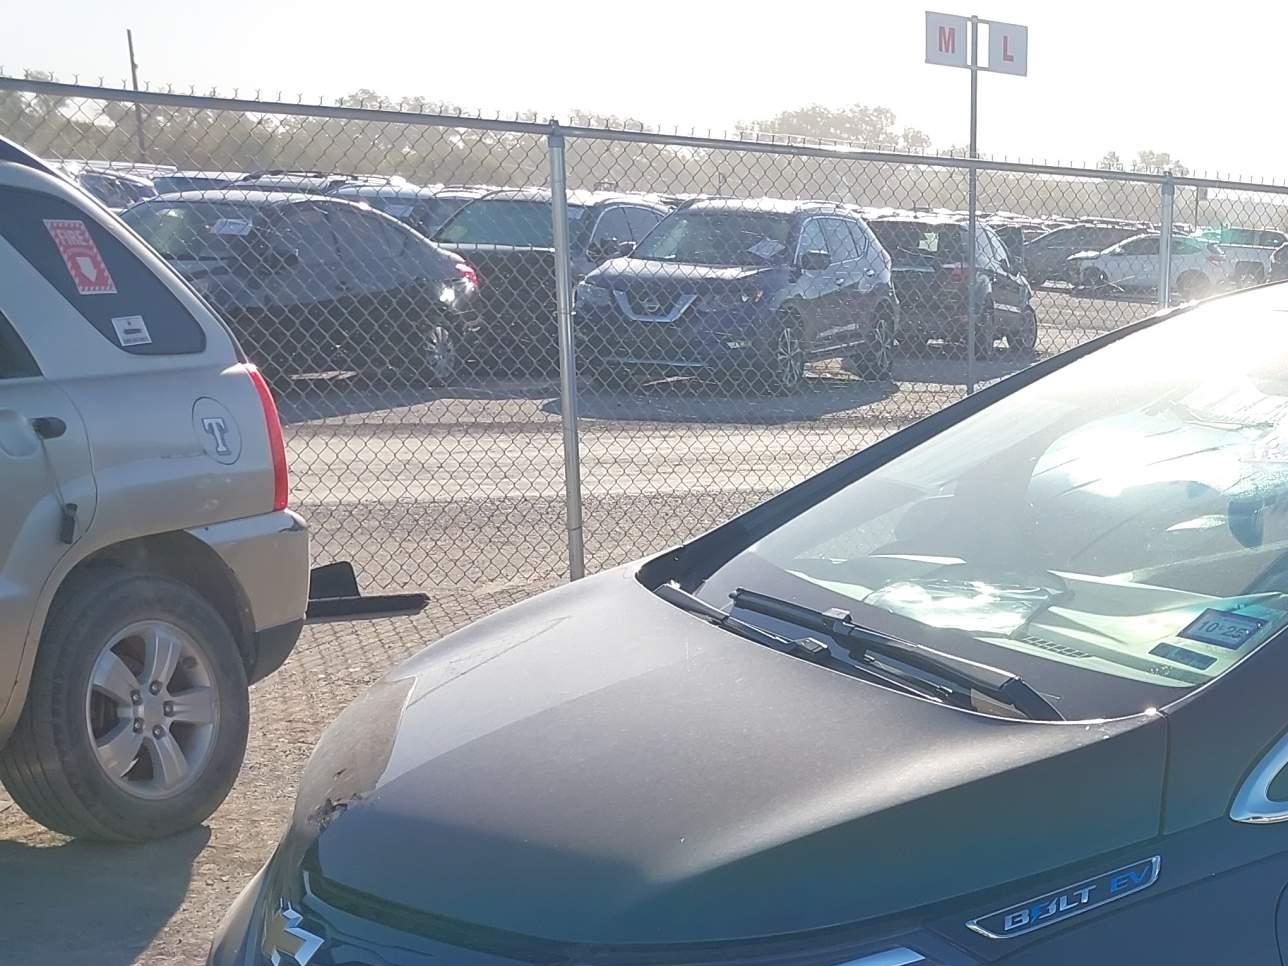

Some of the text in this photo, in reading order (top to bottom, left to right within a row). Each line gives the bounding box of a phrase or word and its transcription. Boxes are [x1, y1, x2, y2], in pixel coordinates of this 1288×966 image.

[938, 25, 956, 54] M
[1002, 35, 1015, 62] L
[55, 229, 89, 246] FIRE
[201, 416, 231, 456] T
[1004, 865, 1149, 931] BOLT EV
